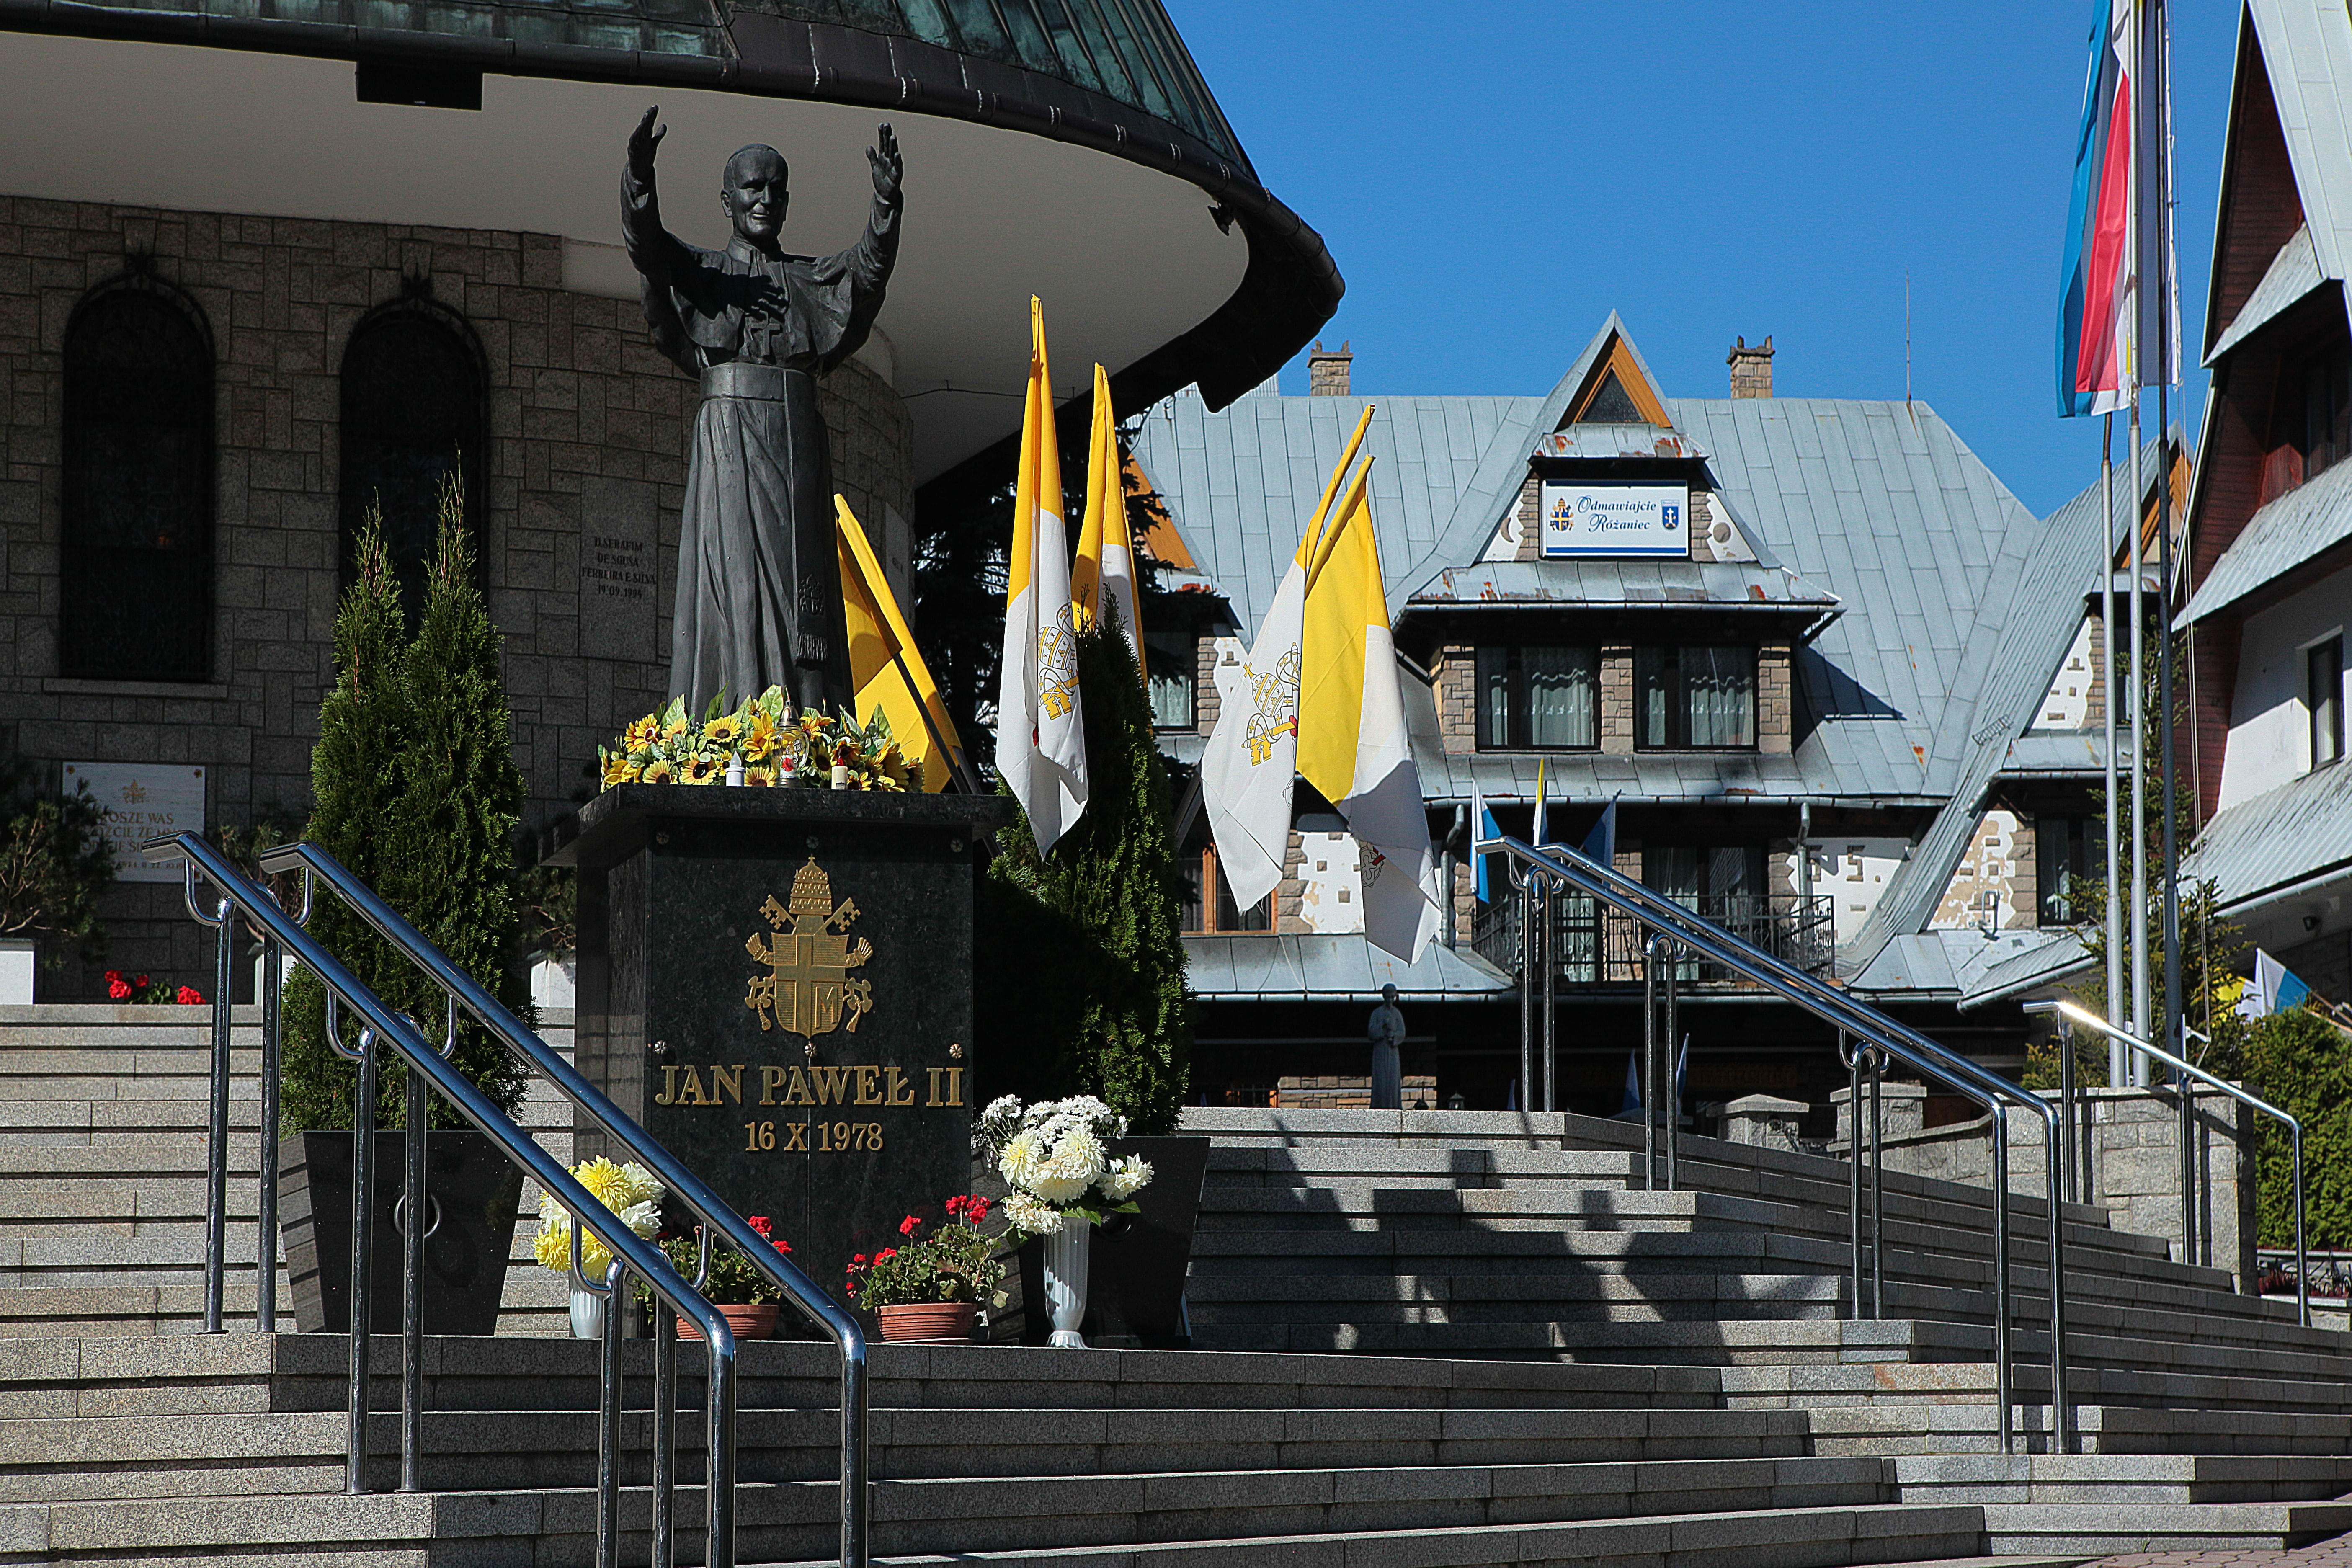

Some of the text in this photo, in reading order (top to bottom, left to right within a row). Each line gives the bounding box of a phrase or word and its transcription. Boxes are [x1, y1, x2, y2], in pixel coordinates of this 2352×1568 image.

[1576, 495, 1656, 513] Odmawiajcie
[1588, 513, 1650, 532] Różaniec
[583, 567, 623, 581] FERREIRA
[655, 1065, 964, 1106] JAN PAWEŁ II
[745, 1121, 883, 1151] 16 X 1978
